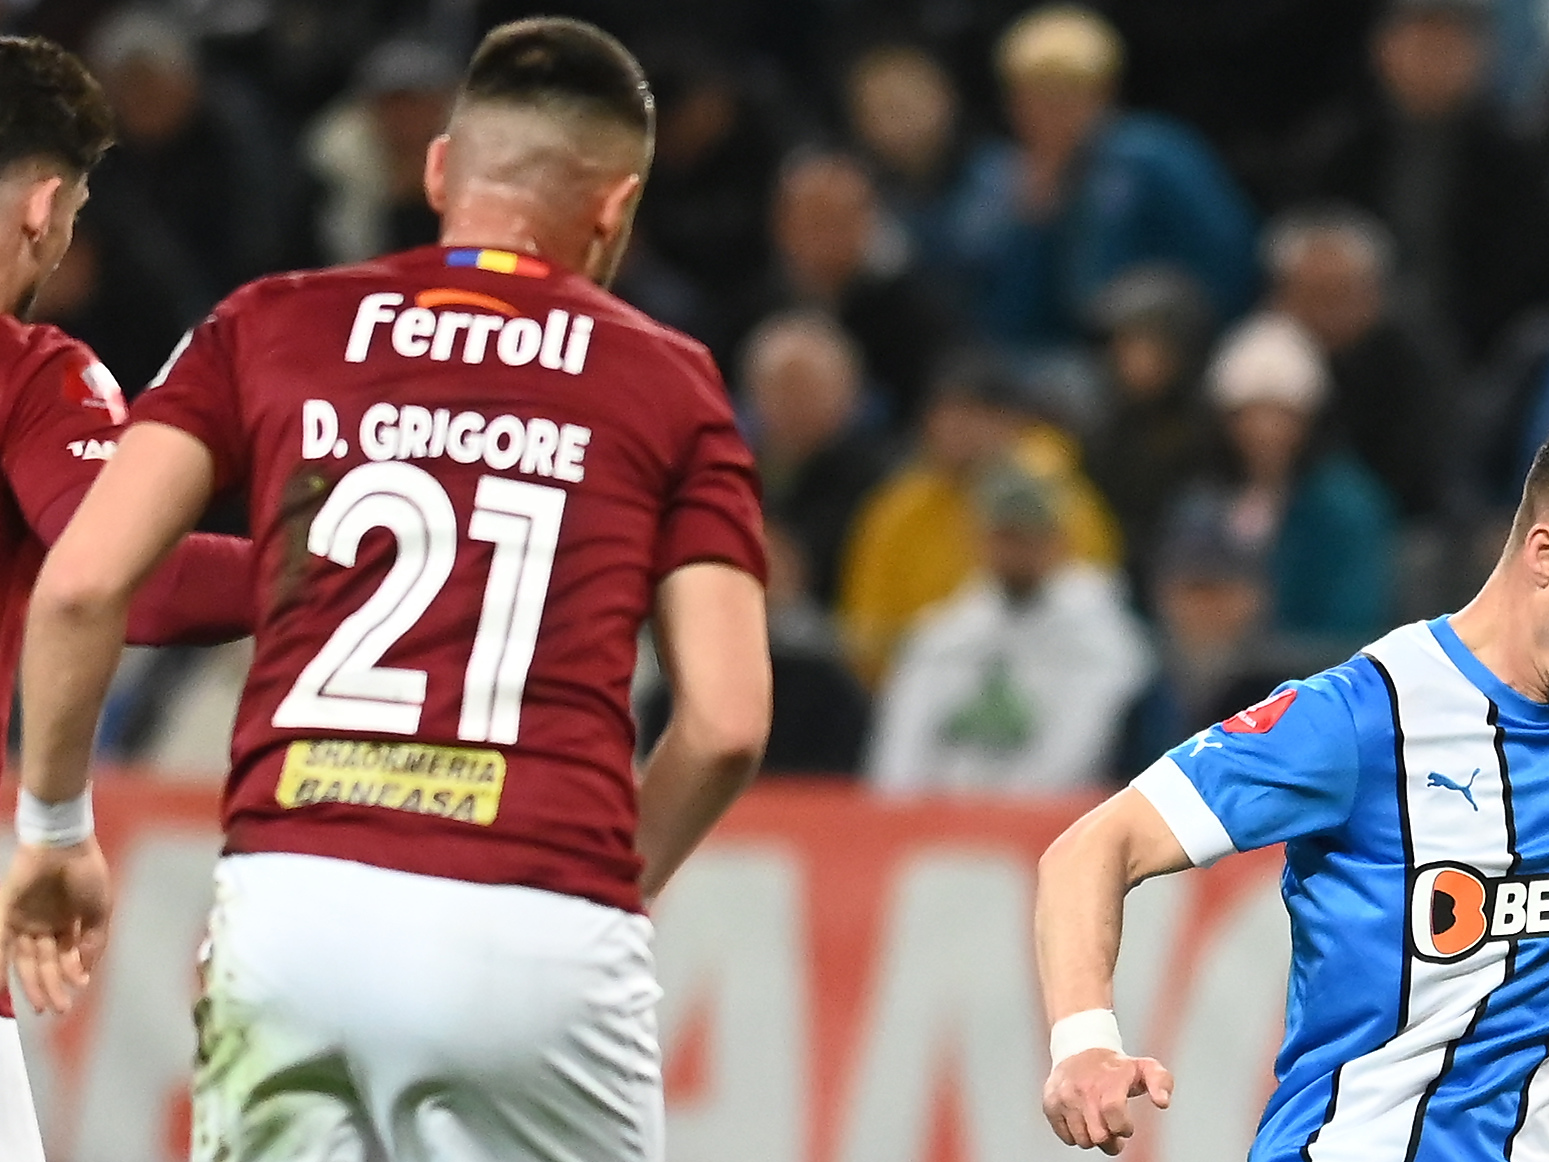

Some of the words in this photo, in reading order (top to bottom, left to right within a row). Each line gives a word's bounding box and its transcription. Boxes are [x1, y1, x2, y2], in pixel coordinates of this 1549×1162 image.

[344, 291, 595, 375] Ferroli
[302, 399, 349, 460] D.
[358, 402, 592, 483] GRIGORE
[272, 461, 567, 744] 21
